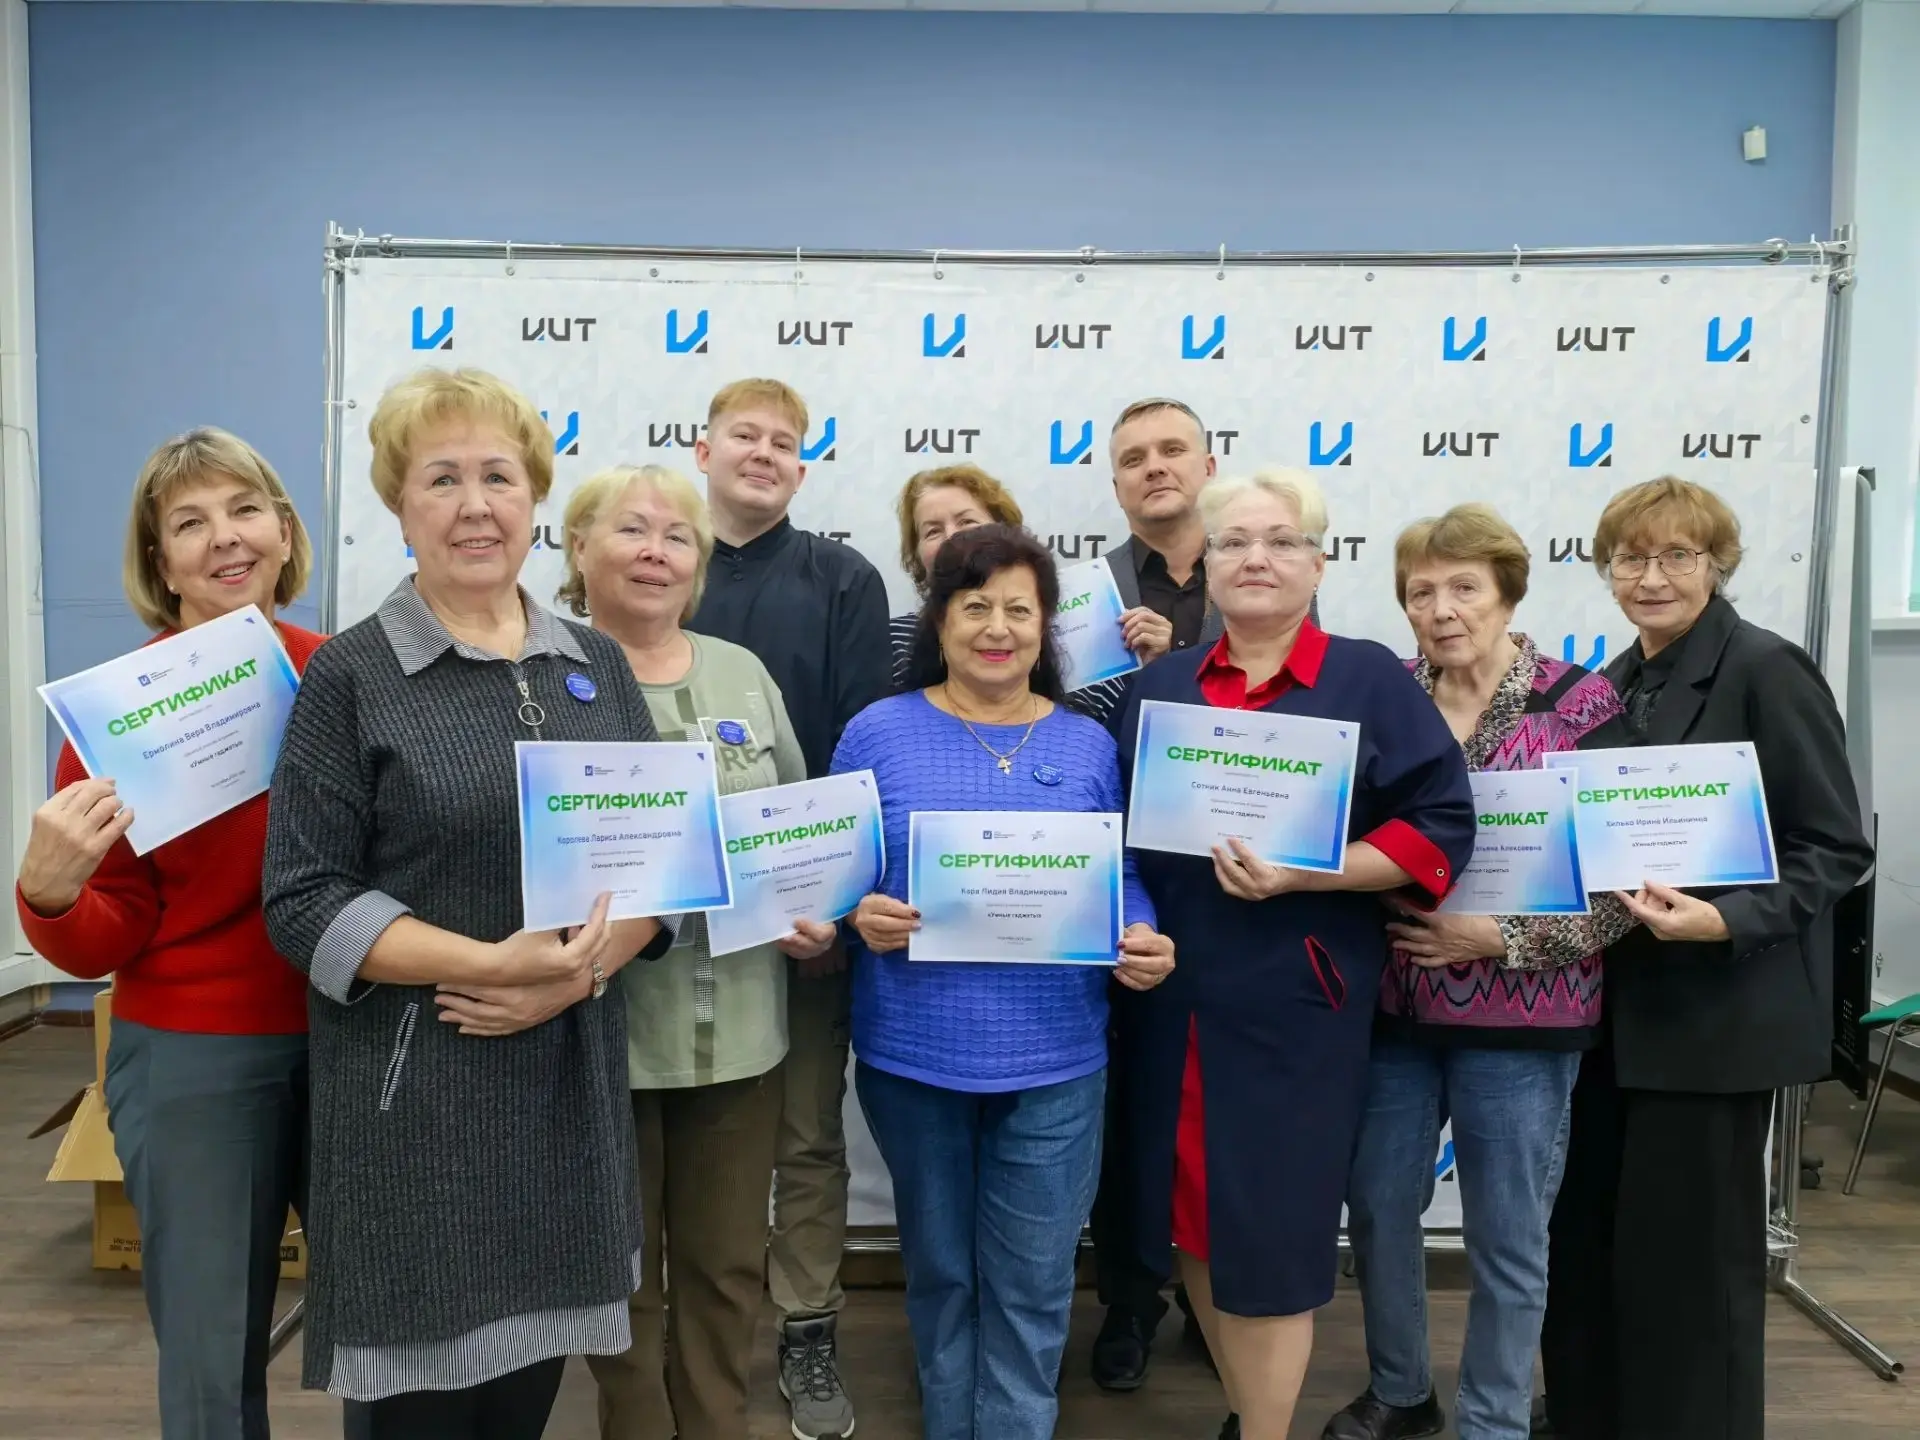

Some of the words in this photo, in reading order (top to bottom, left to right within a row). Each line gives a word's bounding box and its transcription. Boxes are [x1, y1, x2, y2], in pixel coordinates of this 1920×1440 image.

[107, 658, 257, 735] СЕРТИФИКАТ
[142, 737, 185, 760] Ермолина
[184, 728, 205, 742] Вера
[204, 702, 262, 731] Владимировна
[1167, 745, 1323, 776] СЕРТИФИКАТ
[1191, 781, 1219, 792] Сотник
[1222, 785, 1241, 794] Анна
[1243, 787, 1290, 799] Евгеньевна
[1577, 782, 1730, 804] СЕРТИФИКАТ
[547, 791, 688, 812] СЕРТИФИКАТ
[1478, 811, 1549, 826] ФИКАТ
[590, 833, 617, 843] Лариса
[618, 829, 682, 841] Александровна
[726, 815, 857, 854] СЕРТИФИКАТ
[772, 859, 812, 873] Александра
[939, 854, 1091, 869] СЕРТИФИКАТ
[1009, 888, 1068, 897] Владимировна
